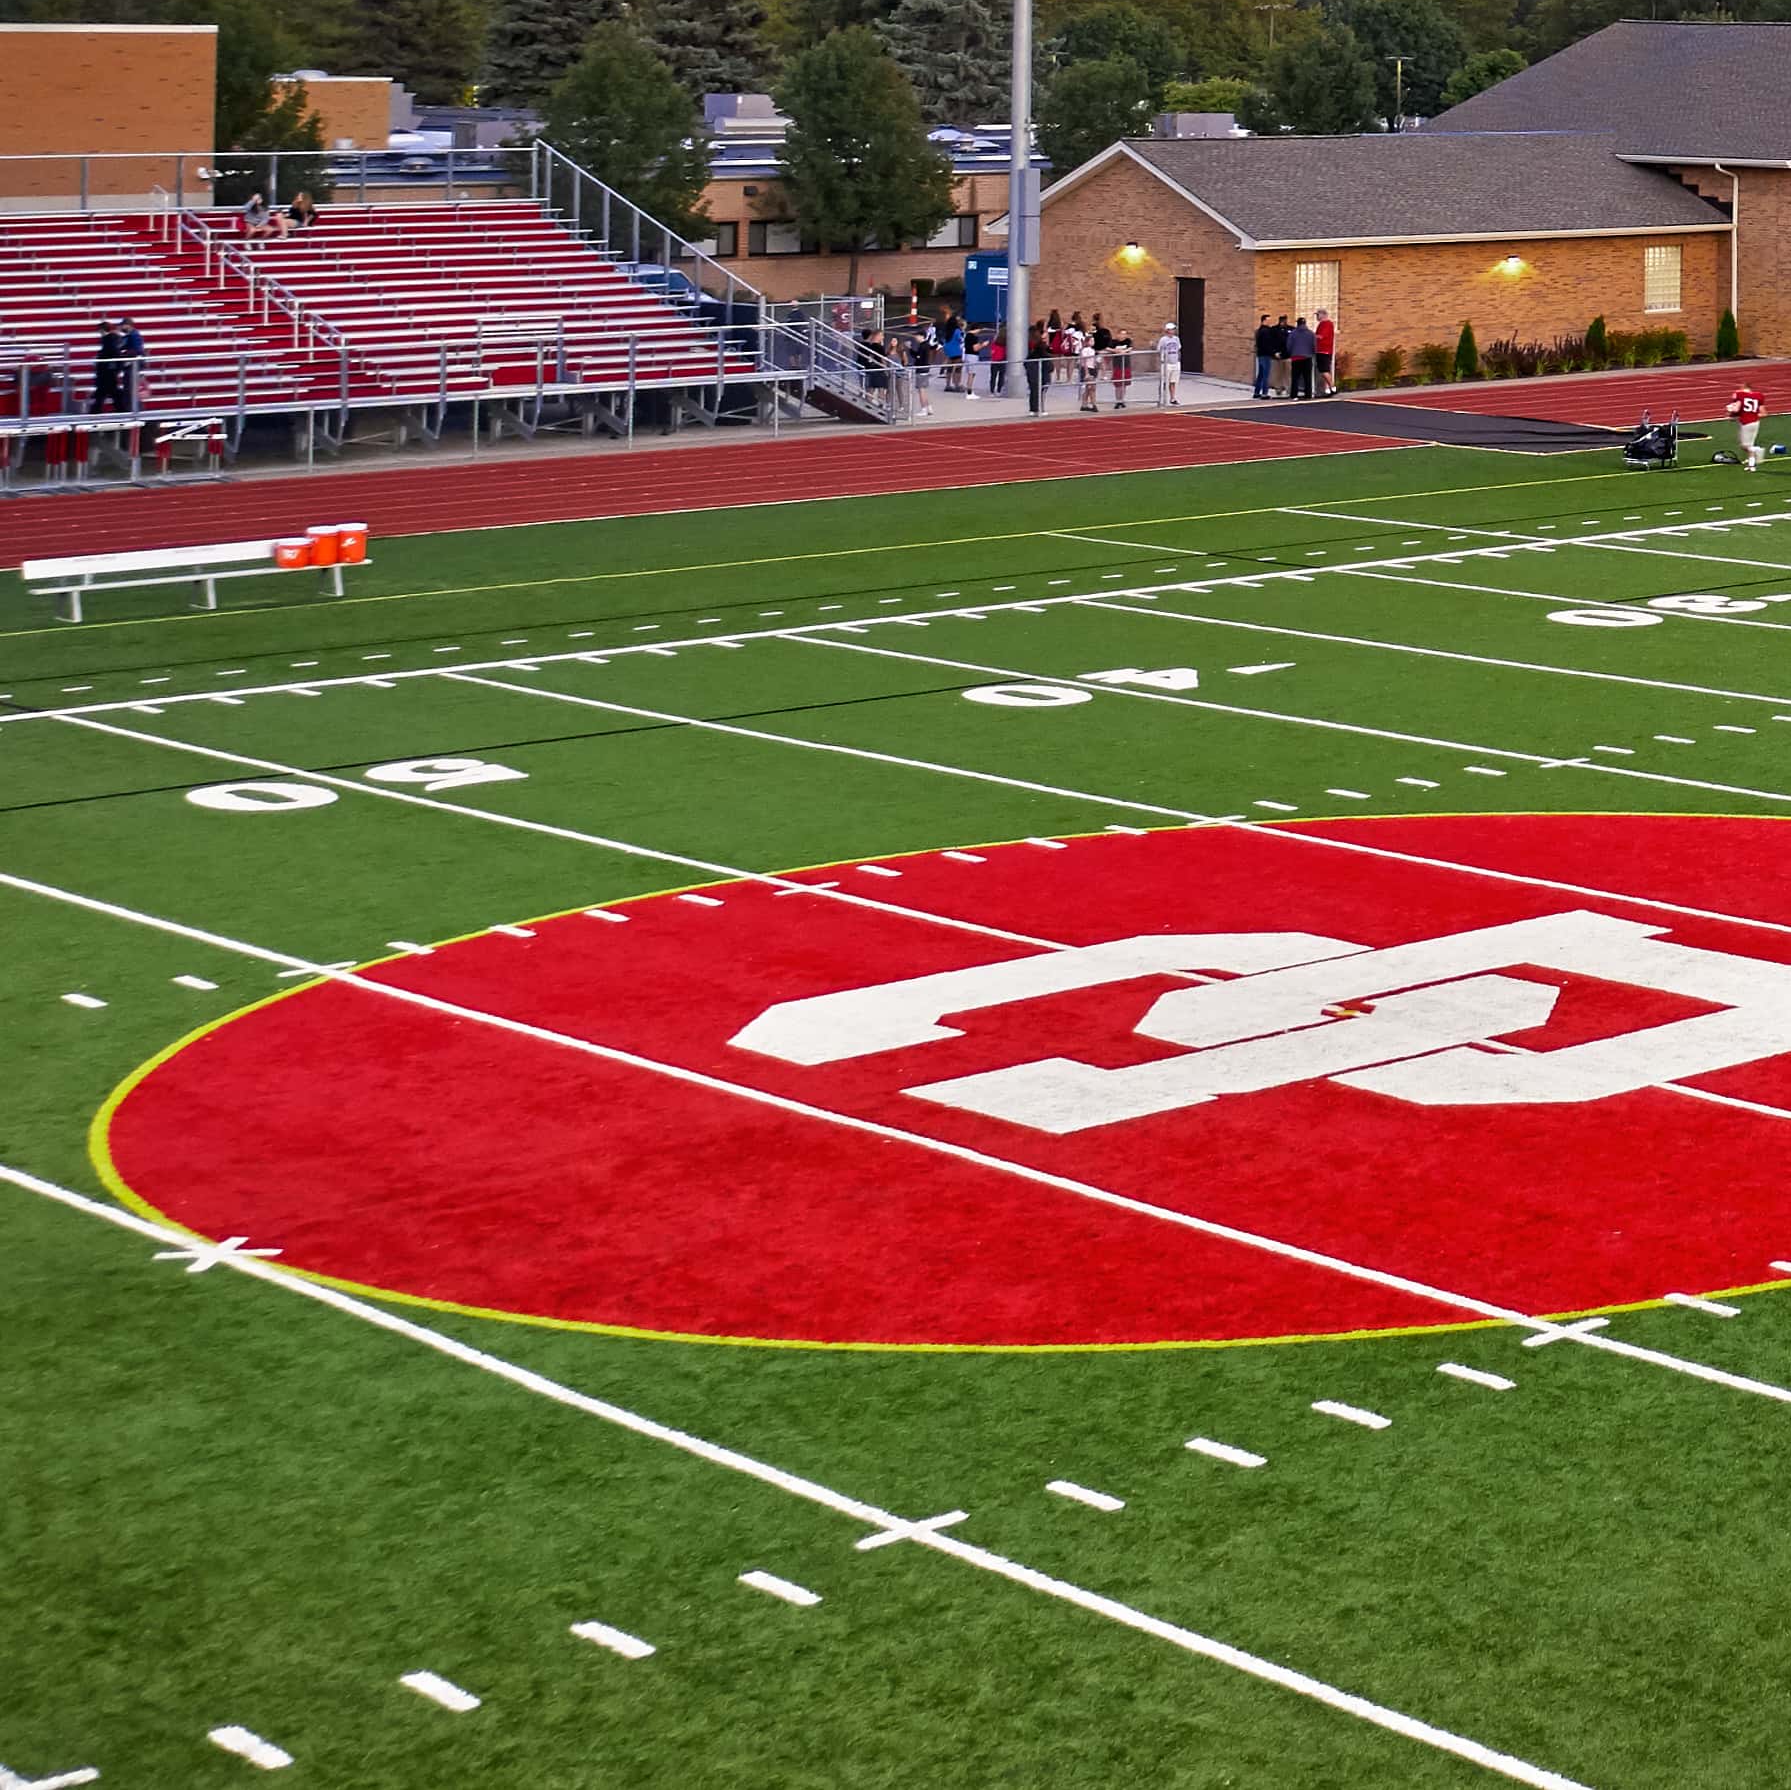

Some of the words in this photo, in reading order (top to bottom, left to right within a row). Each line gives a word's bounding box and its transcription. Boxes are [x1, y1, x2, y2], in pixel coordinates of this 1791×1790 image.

[1743, 398, 1759, 413] 51
[1546, 592, 1769, 627] 30
[961, 666, 1200, 708] 40
[184, 756, 530, 812] 50
